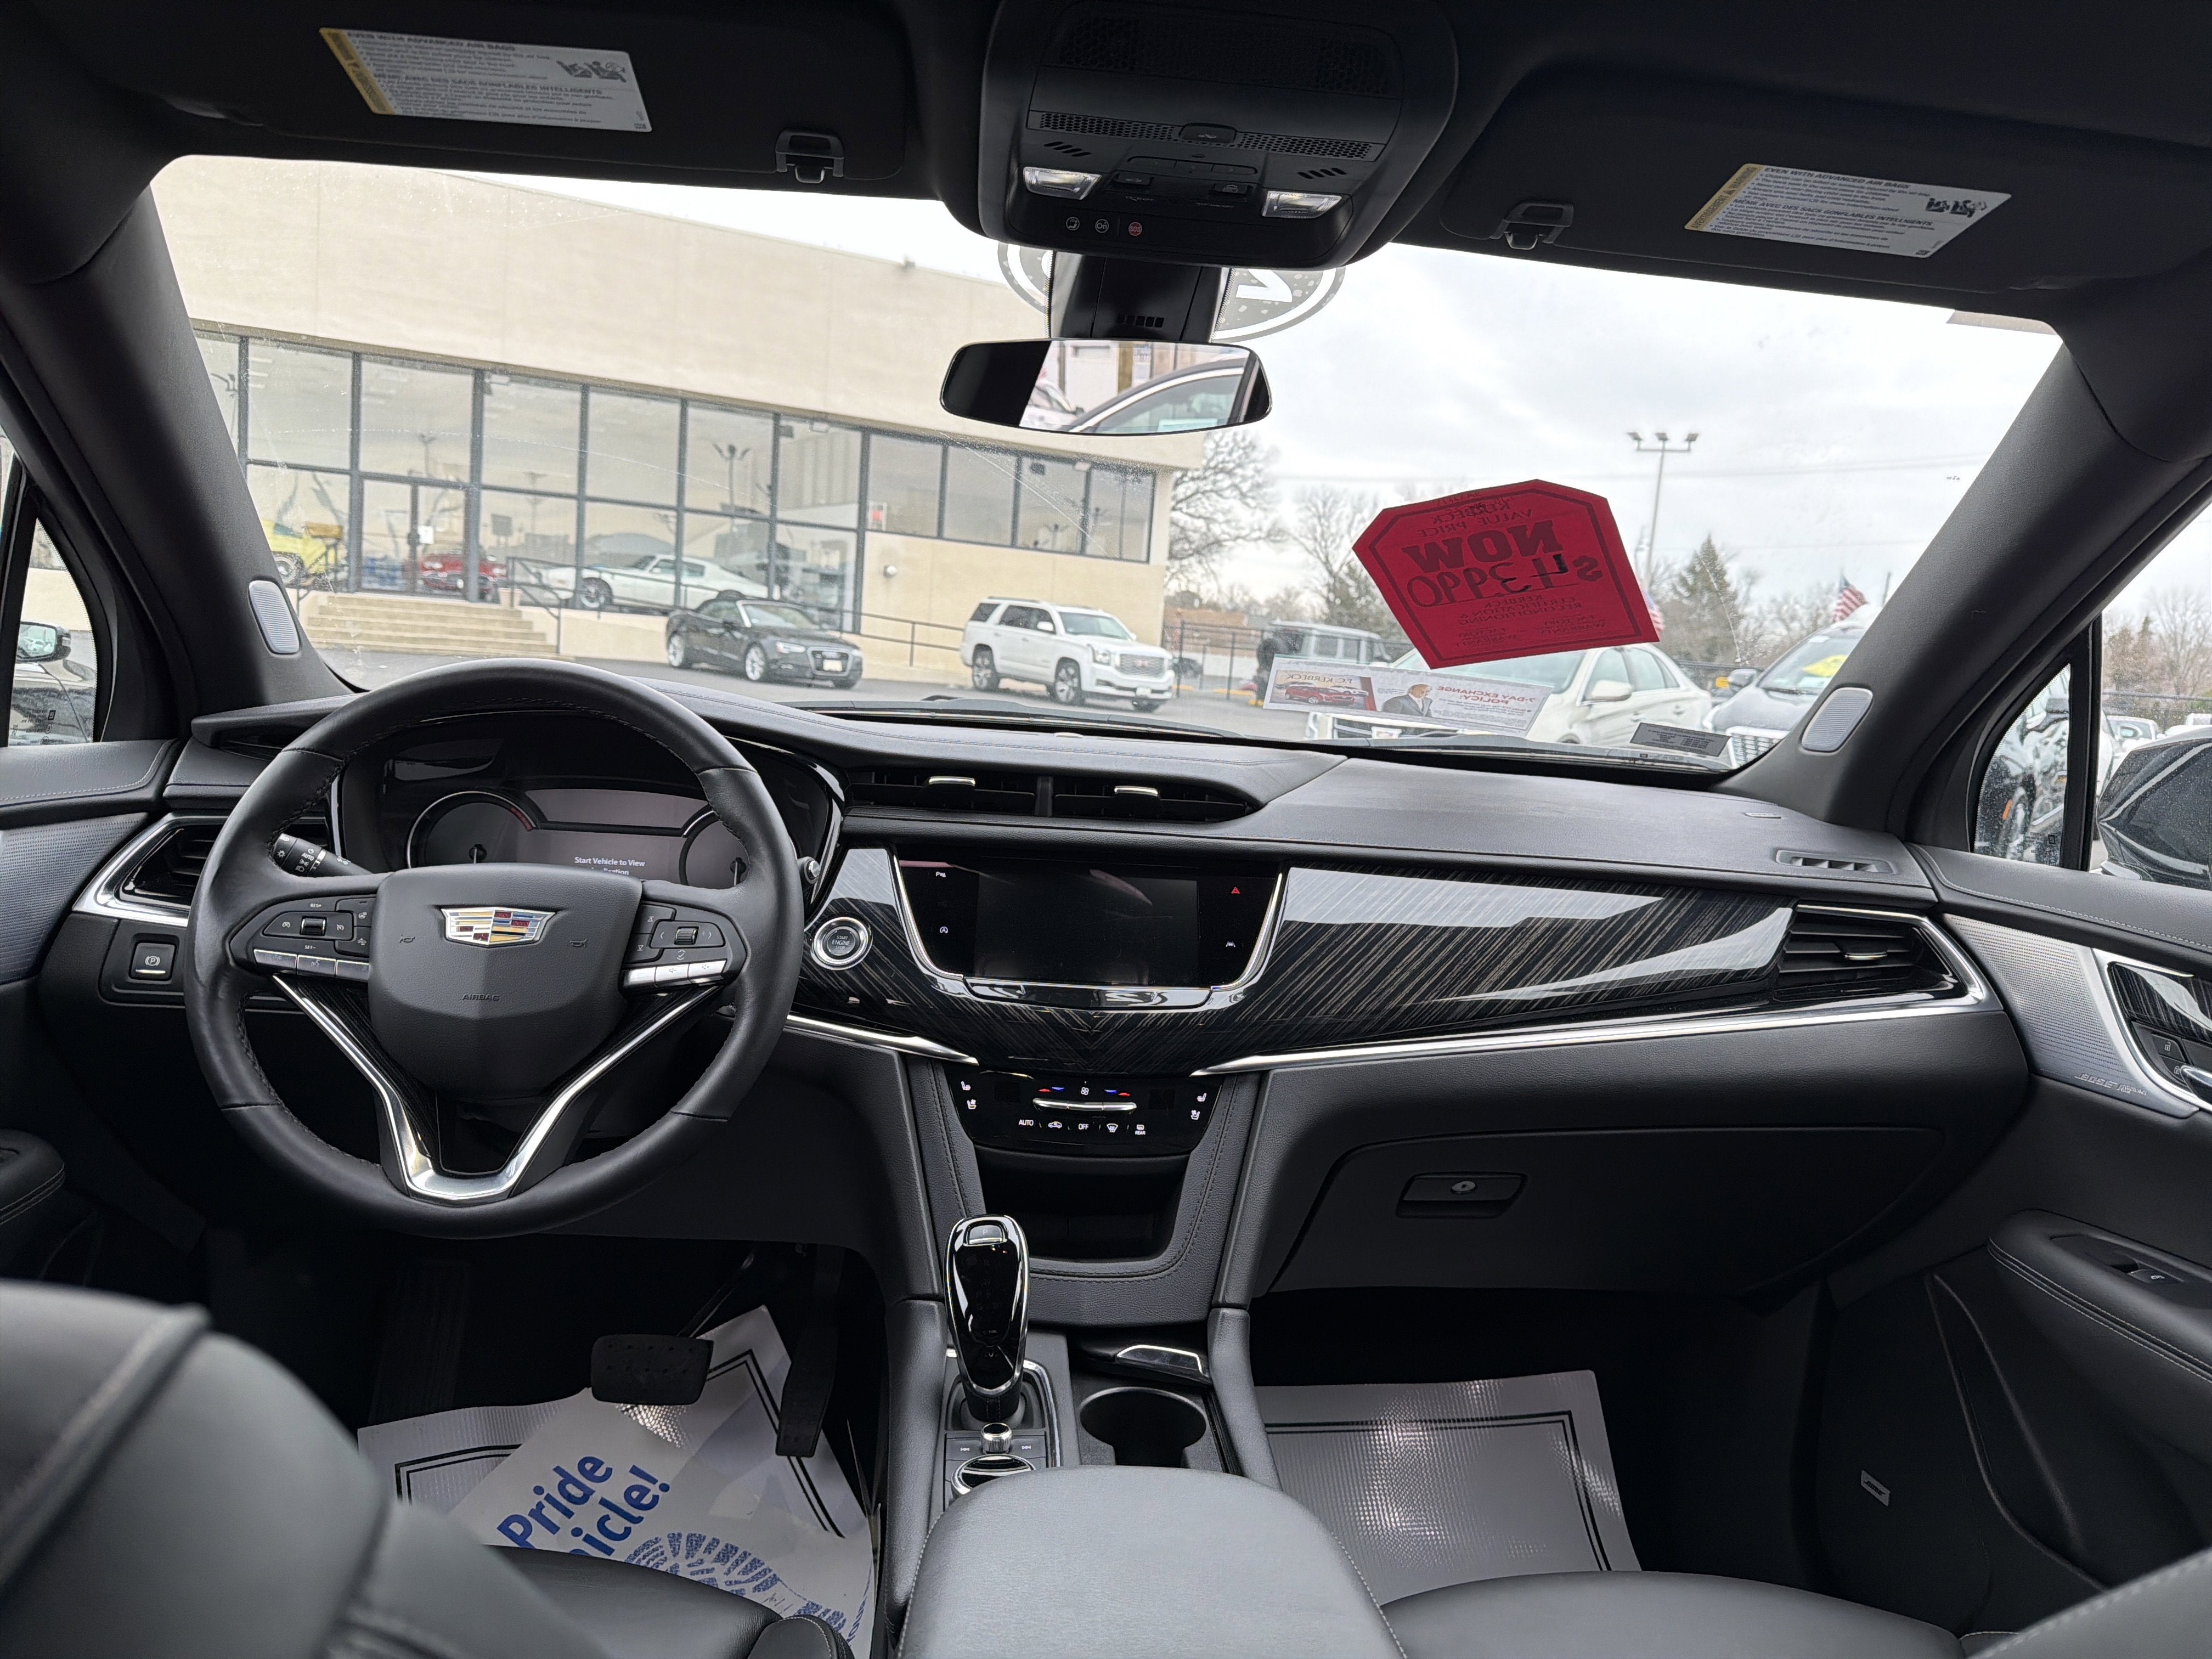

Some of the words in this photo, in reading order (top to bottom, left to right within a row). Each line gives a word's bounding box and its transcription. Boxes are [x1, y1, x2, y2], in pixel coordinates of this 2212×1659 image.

[1814, 173, 1867, 183] ADVANCED
[1822, 209, 1876, 219] GONFLABLES
[1875, 215, 1934, 226] INTELLIGENTS
[301, 853, 314, 861] AUTO
[592, 857, 618, 866] Vehicle
[2074, 1073, 2118, 1088] BOSE
[496, 1457, 613, 1549] Pride
